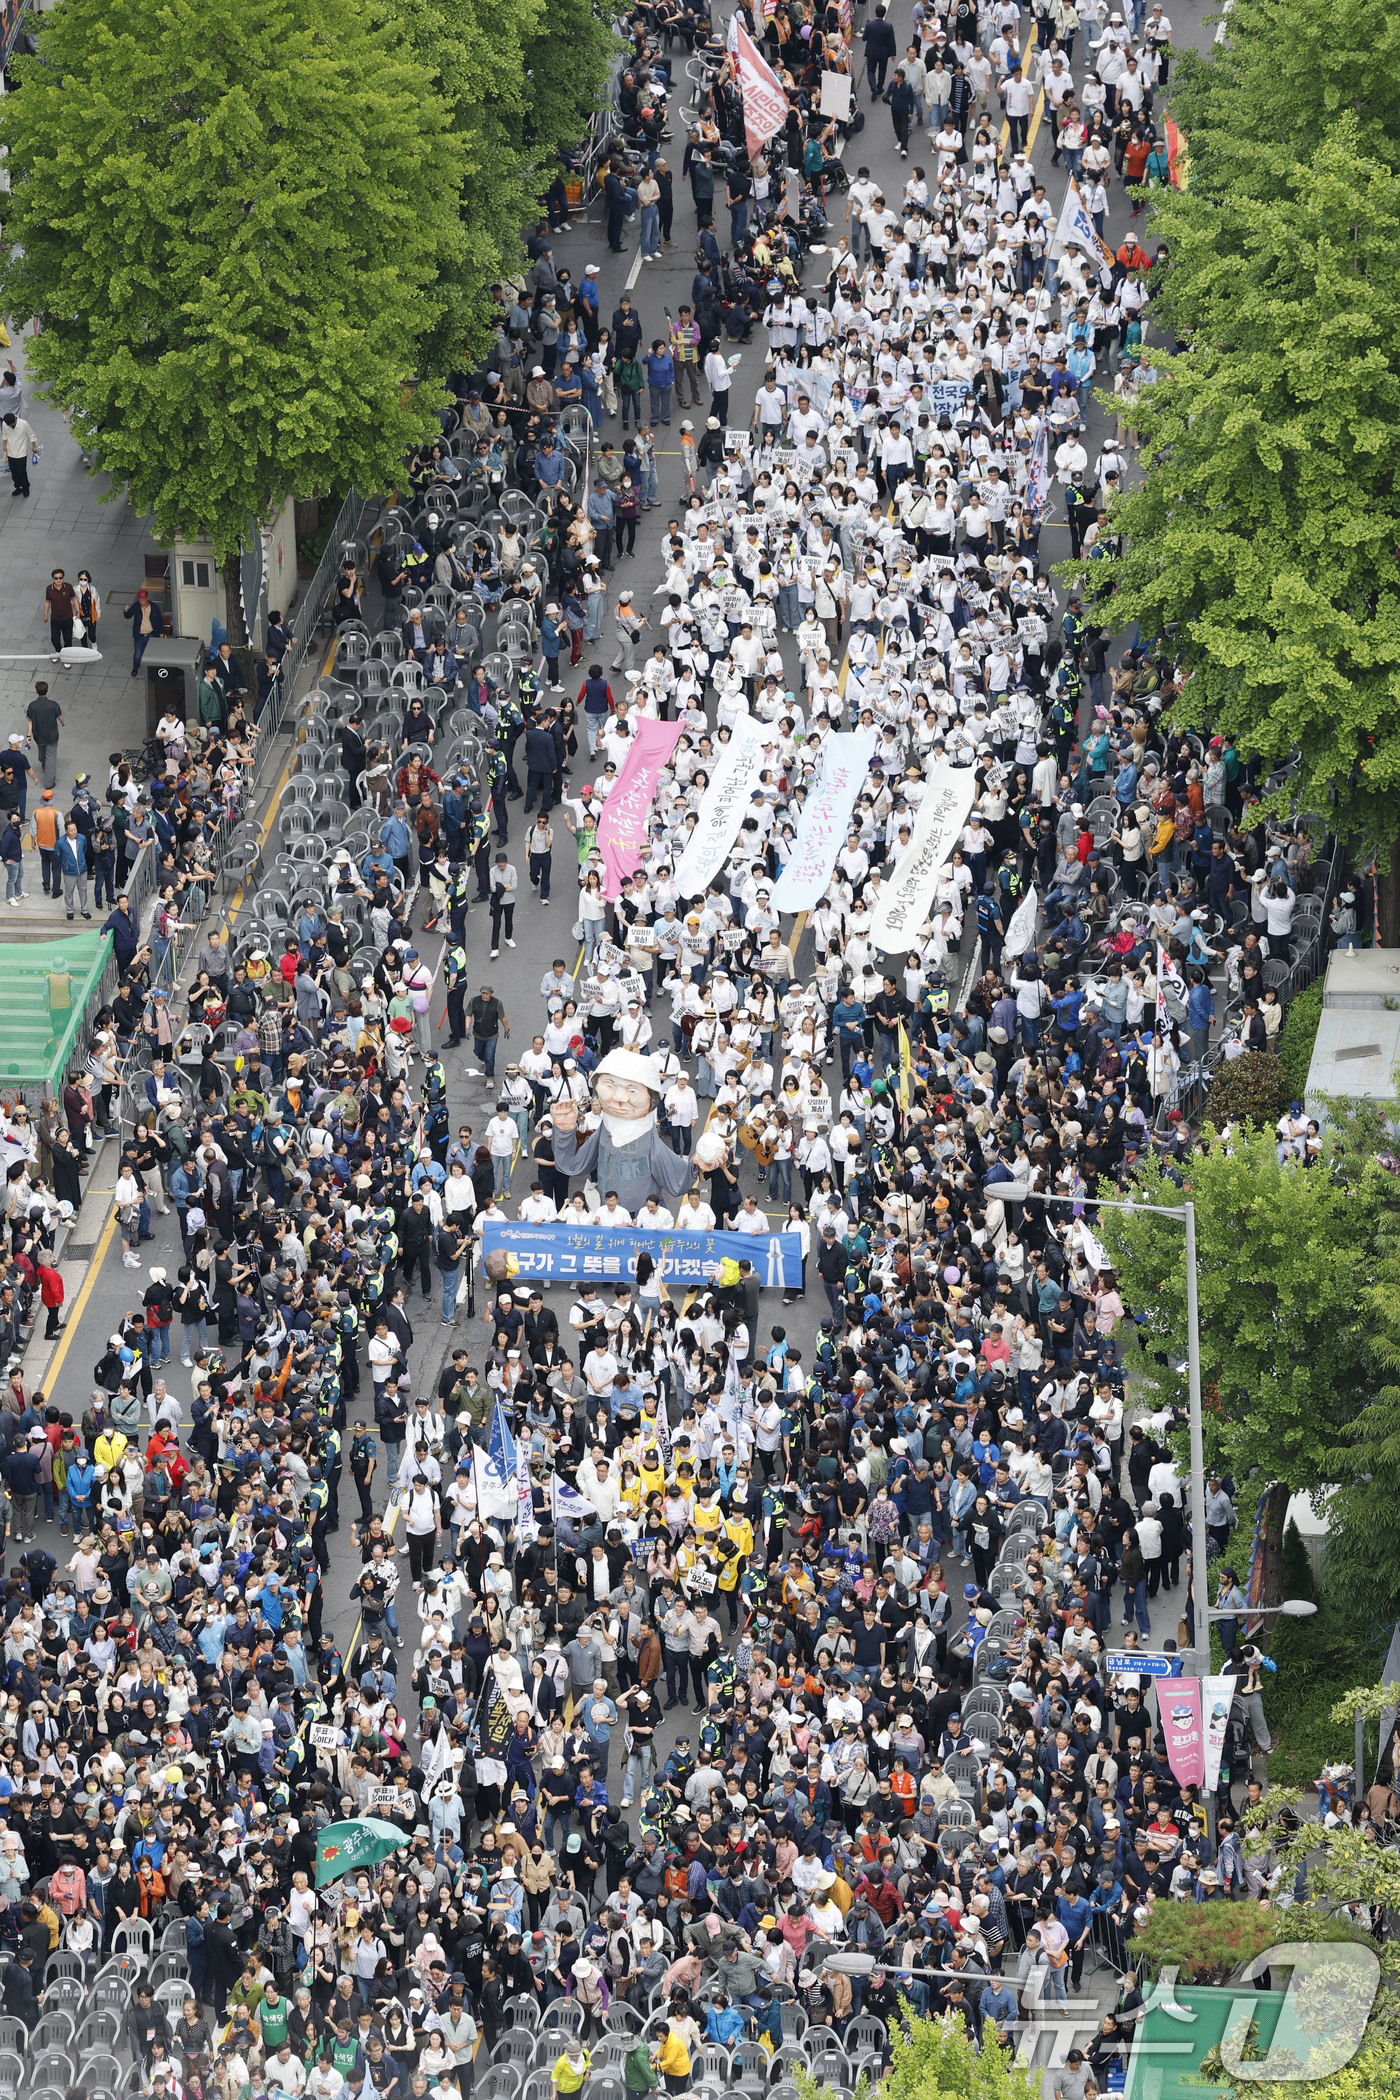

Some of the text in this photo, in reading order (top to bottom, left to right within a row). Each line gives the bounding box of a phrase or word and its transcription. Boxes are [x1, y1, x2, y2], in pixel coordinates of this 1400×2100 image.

[743, 84, 787, 125] 시민으로
[743, 101, 776, 135] 주주의
[566, 1233, 591, 1249] 오월의
[594, 1234, 606, 1250] 길
[608, 1238, 625, 1249] 위에
[629, 1237, 655, 1250] 피어난
[704, 1238, 716, 1254] 꽃
[560, 1254, 577, 1273] 그
[583, 1255, 620, 1274] 뜻을
[1108, 1657, 1131, 1666] 금남로
[315, 1726, 334, 1736] 투표가
[467, 1948, 483, 1958] STAFF
[262, 2013, 284, 2023] 녹색당
